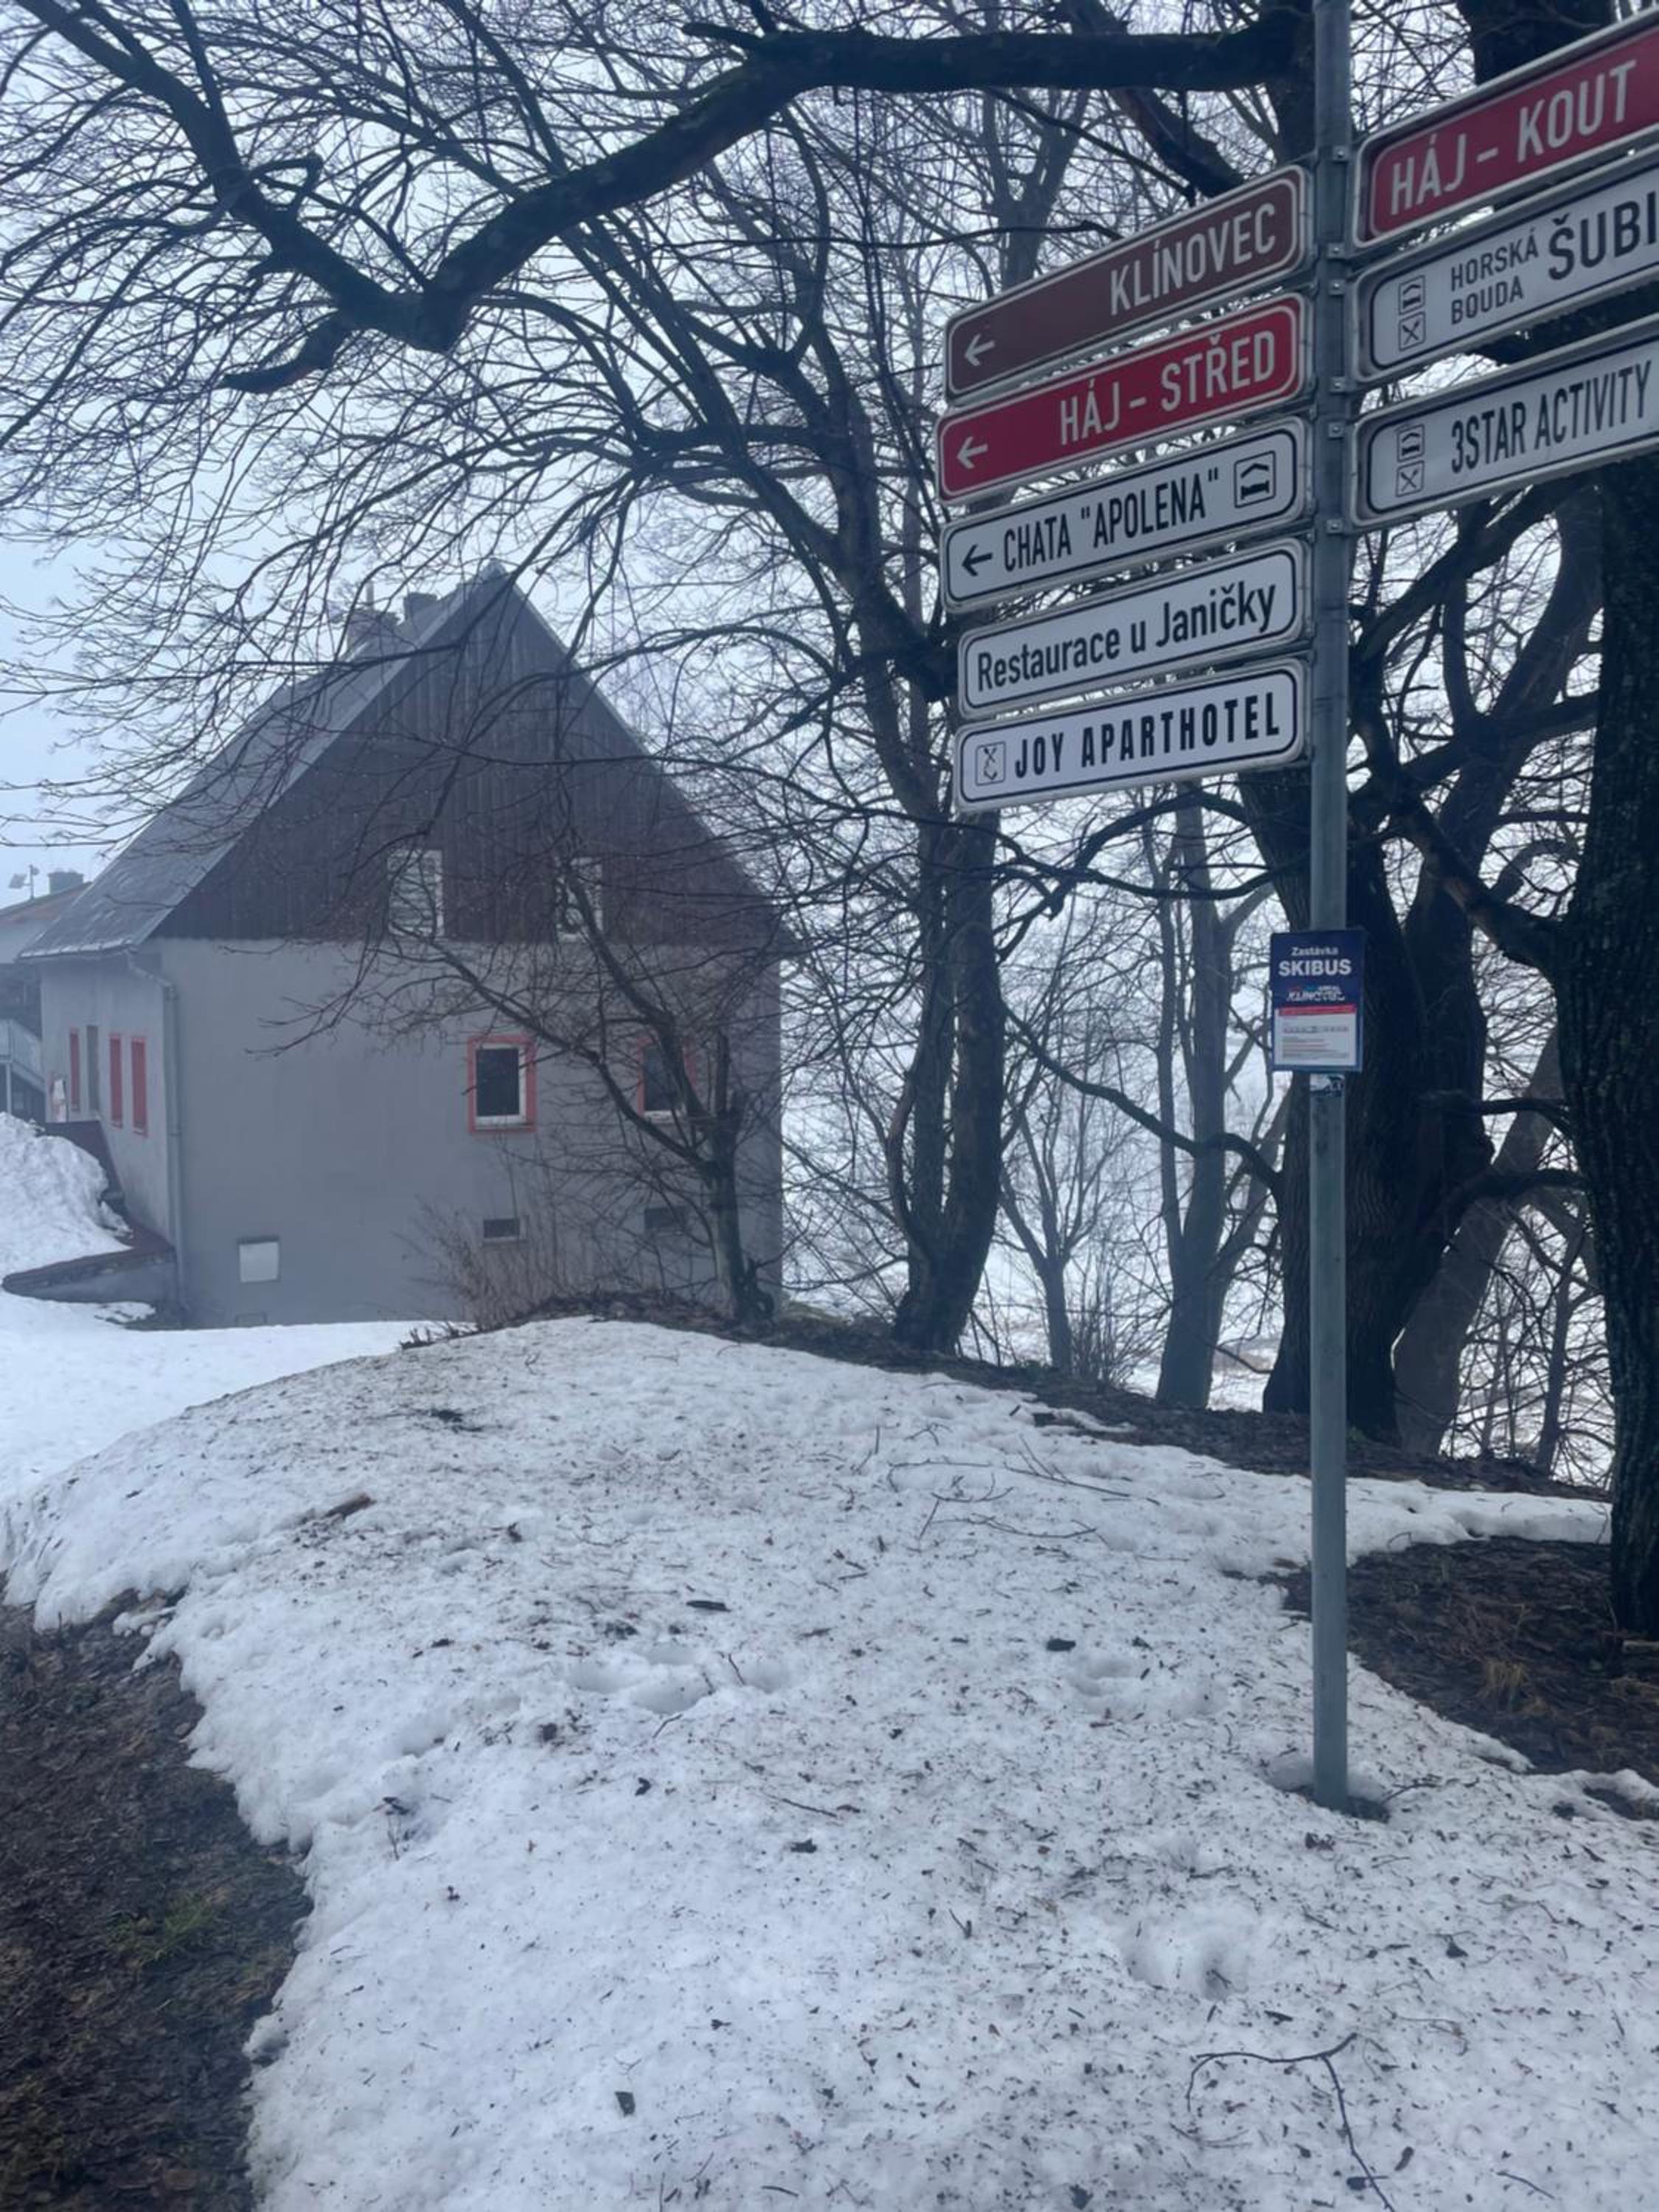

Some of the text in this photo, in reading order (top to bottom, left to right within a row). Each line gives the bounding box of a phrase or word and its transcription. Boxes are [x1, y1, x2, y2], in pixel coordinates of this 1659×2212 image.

[1390, 131, 1467, 216] HÁJ
[1517, 58, 1638, 164] KOUT
[1110, 202, 1276, 316] KLÍNOVEC
[1450, 226, 1540, 292] HORSKÁ
[1450, 276, 1524, 325] BOUDA
[1060, 377, 1121, 445] HÁJ
[1161, 330, 1276, 412] STŘED
[1450, 359, 1652, 474] 3STAR ACTIVITY
[1003, 467, 1220, 573] CHATA "APOLENA"
[977, 581, 1276, 693] Restaurace u Janičky
[1014, 691, 1281, 780] JOY APARTHOTEL
[1279, 959, 1352, 976] SKIBUS
